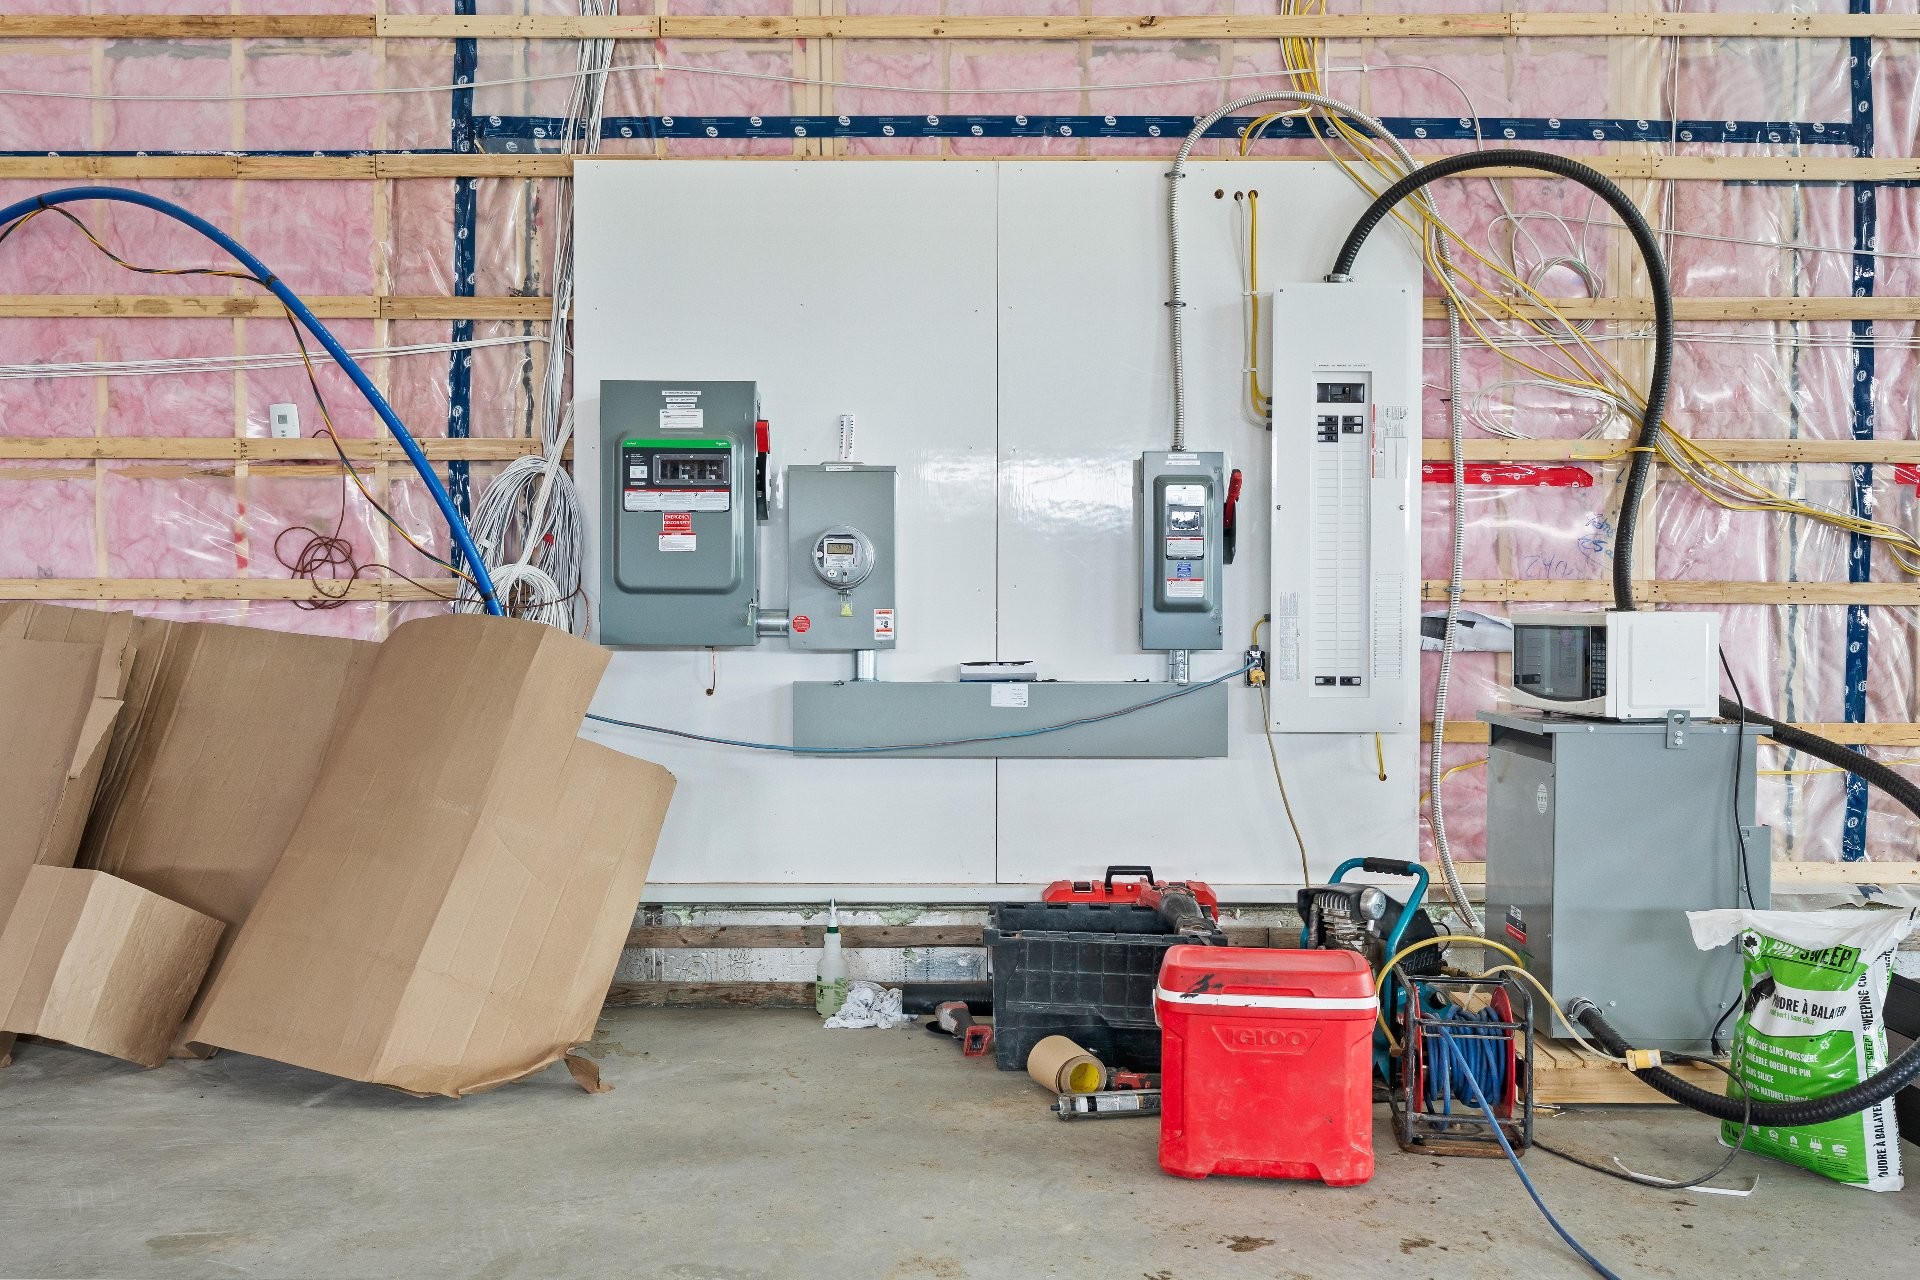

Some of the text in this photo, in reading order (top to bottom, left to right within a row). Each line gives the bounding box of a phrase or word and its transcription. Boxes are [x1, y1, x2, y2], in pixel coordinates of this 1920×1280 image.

[1800, 946, 1853, 968] SWEEP
[1801, 999, 1808, 1015] À
[1858, 990, 1874, 1031] SWEEPING
[1227, 1028, 1307, 1047] IGLOO
[1746, 1035, 1768, 1052] BALAGE
[1768, 1043, 1785, 1057] SANS
[1745, 1065, 1774, 1084] SANS SILICE
[1769, 1058, 1788, 1073] ODEUR
[1789, 1065, 1798, 1075] DE
[1799, 1068, 1811, 1078] PIN
[1877, 1148, 1889, 1178] OUDRE
